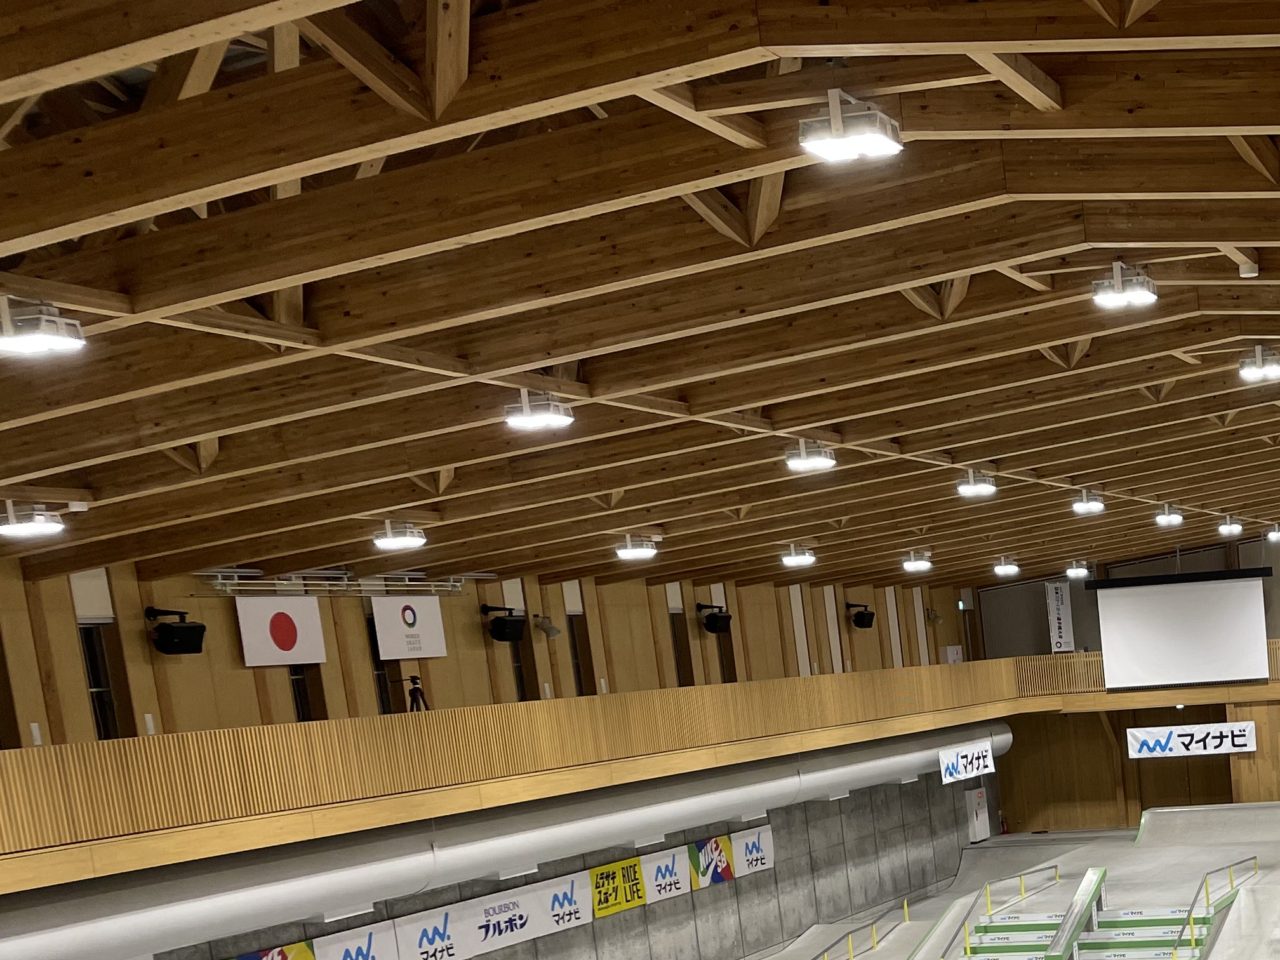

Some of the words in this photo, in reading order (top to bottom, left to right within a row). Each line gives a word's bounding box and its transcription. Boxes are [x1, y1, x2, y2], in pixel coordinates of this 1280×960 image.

[1177, 728, 1248, 751] マイナビ
[960, 749, 989, 774] マイナビ
[699, 838, 720, 872] NIKE
[717, 851, 728, 873] SB
[746, 855, 766, 869] マイナビ
[595, 870, 616, 889] ムラサキ
[621, 864, 639, 884] RIDE
[597, 885, 618, 906] スポーツ
[624, 882, 643, 903] LIFE
[655, 879, 681, 895] マイナビ
[484, 900, 520, 918] BOURBON
[552, 908, 581, 926] マイナビ
[478, 913, 529, 942] ブルボン
